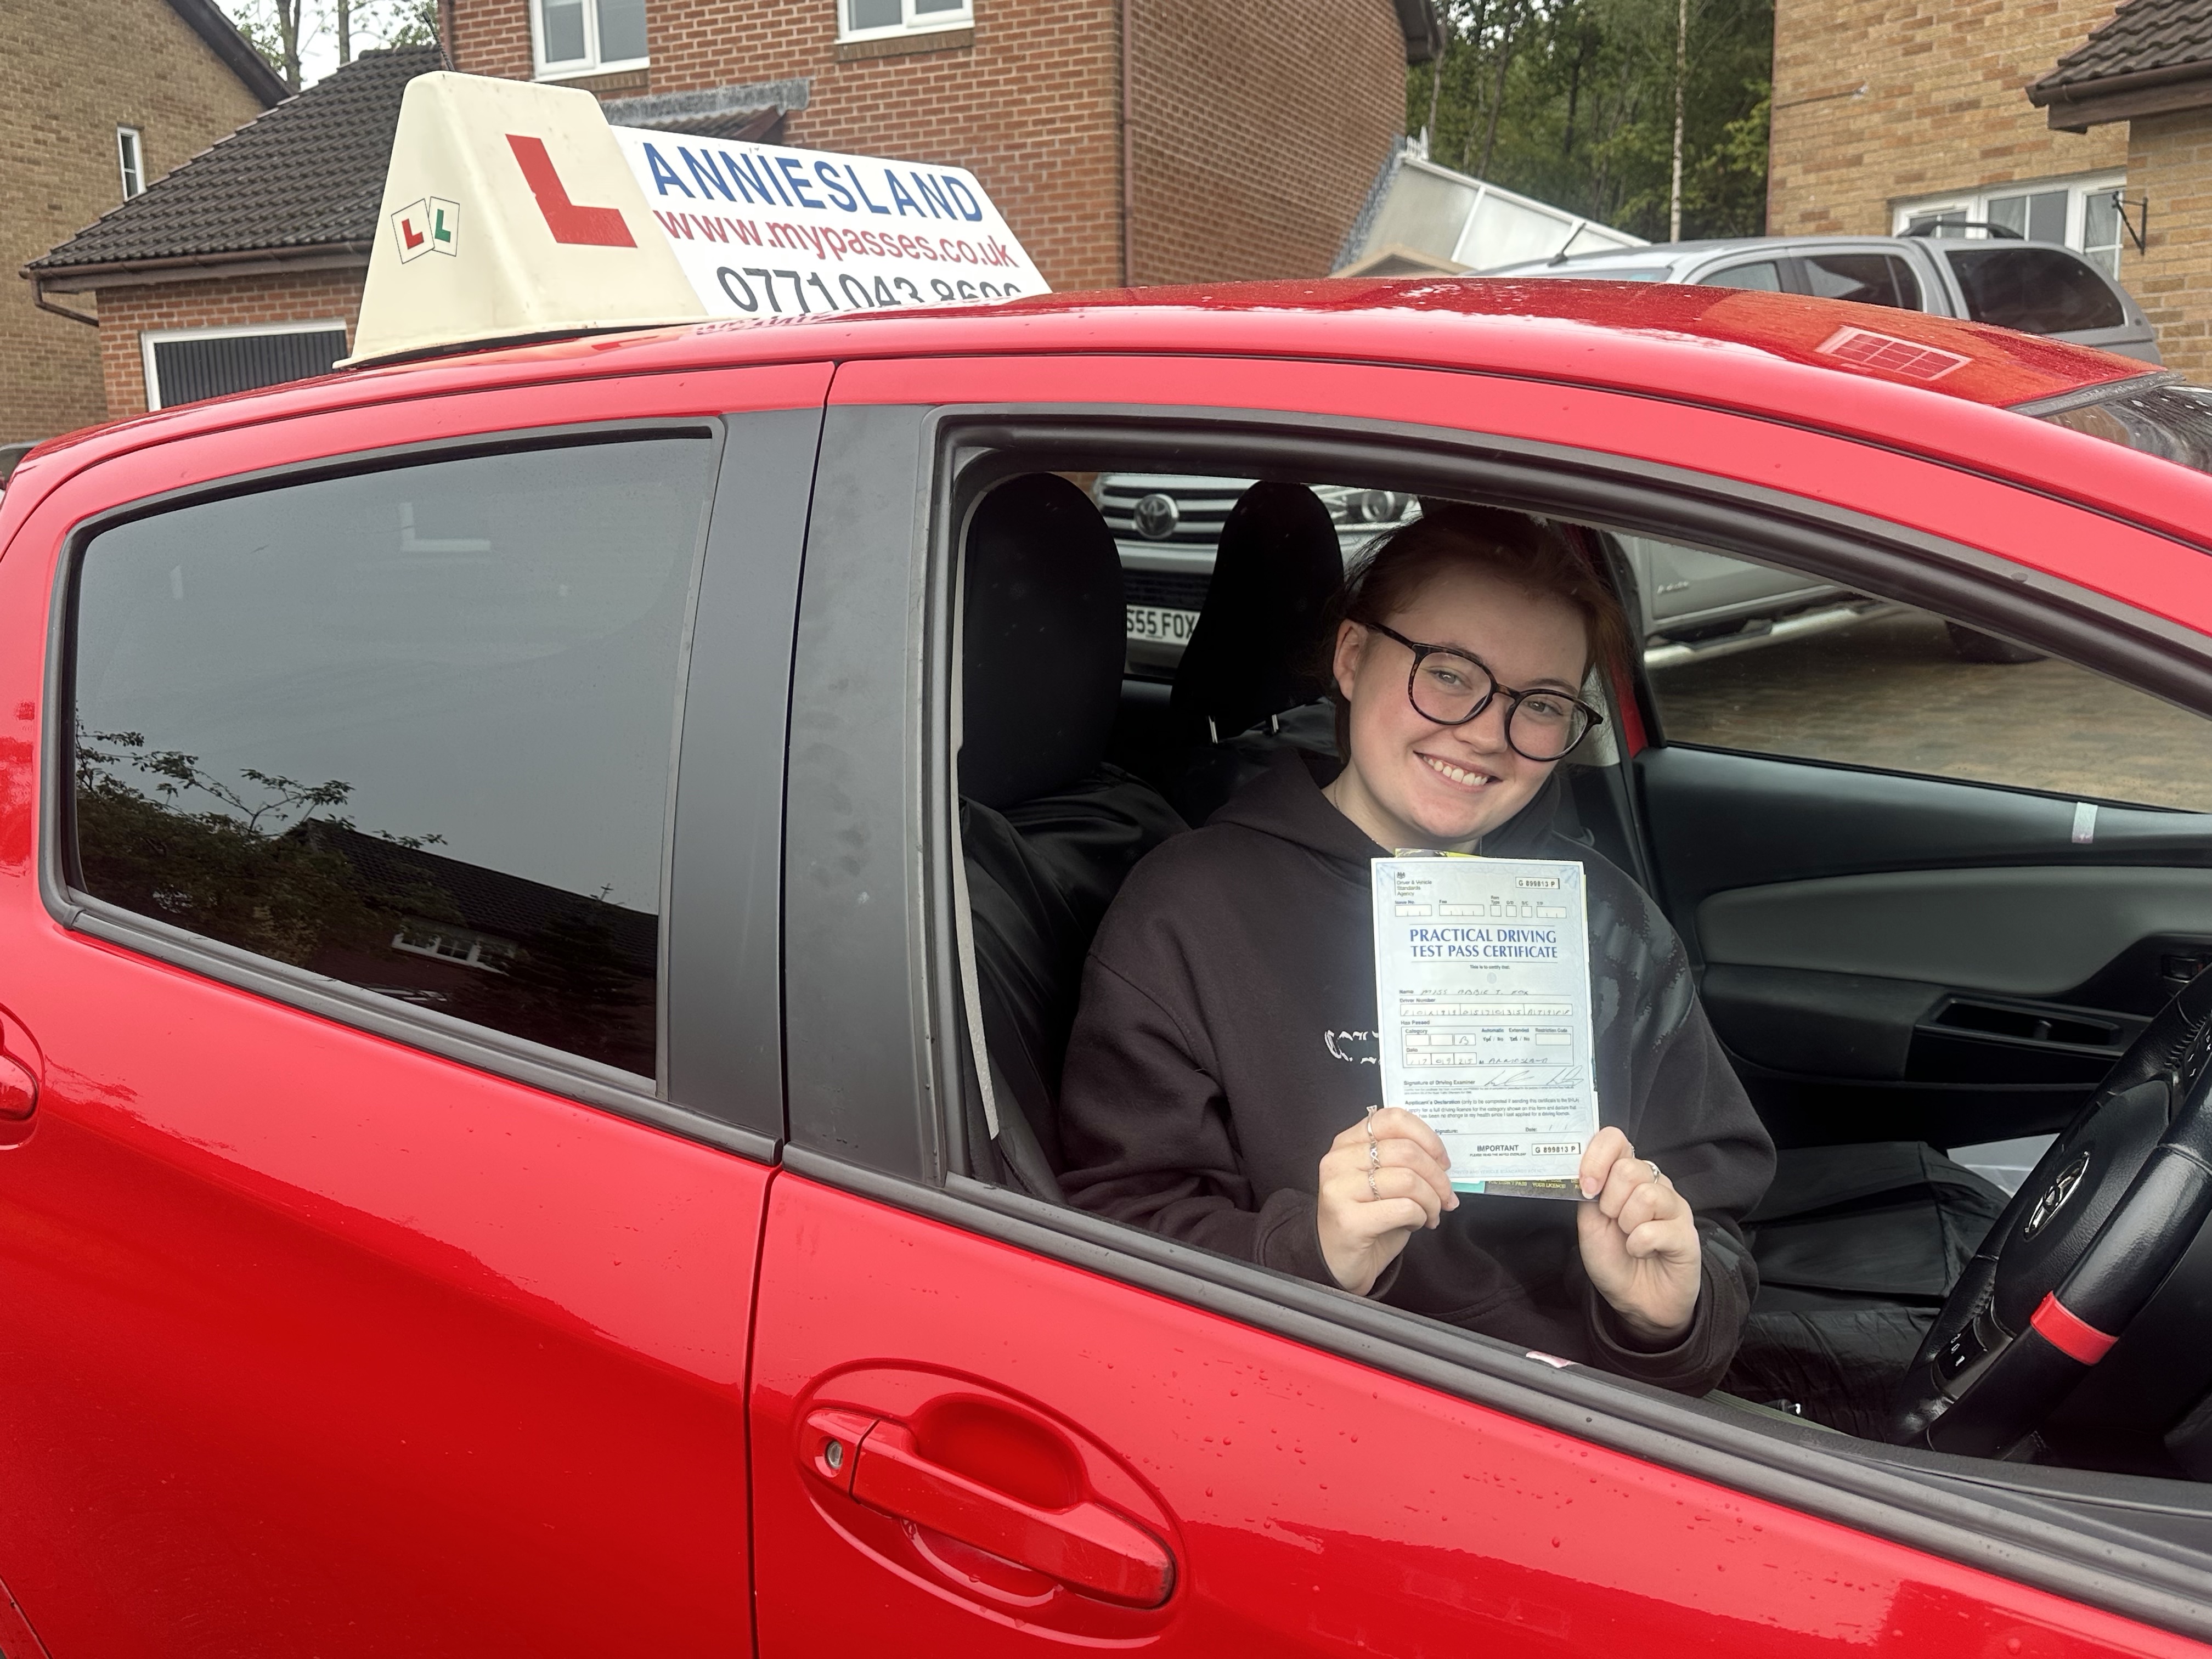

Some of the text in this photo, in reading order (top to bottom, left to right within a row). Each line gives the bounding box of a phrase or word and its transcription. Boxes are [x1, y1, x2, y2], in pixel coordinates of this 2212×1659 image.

[505, 134, 638, 248] L
[642, 142, 983, 222] ANNIESLAND
[402, 218, 424, 250] L
[435, 208, 451, 243] L
[652, 210, 1020, 268] www.mypasses.co.uk
[1162, 612, 1195, 639] FOX
[1410, 929, 1556, 943] PRACTICAL DRIVING
[1410, 945, 1558, 958] TEST PASS CERTIFICATE
